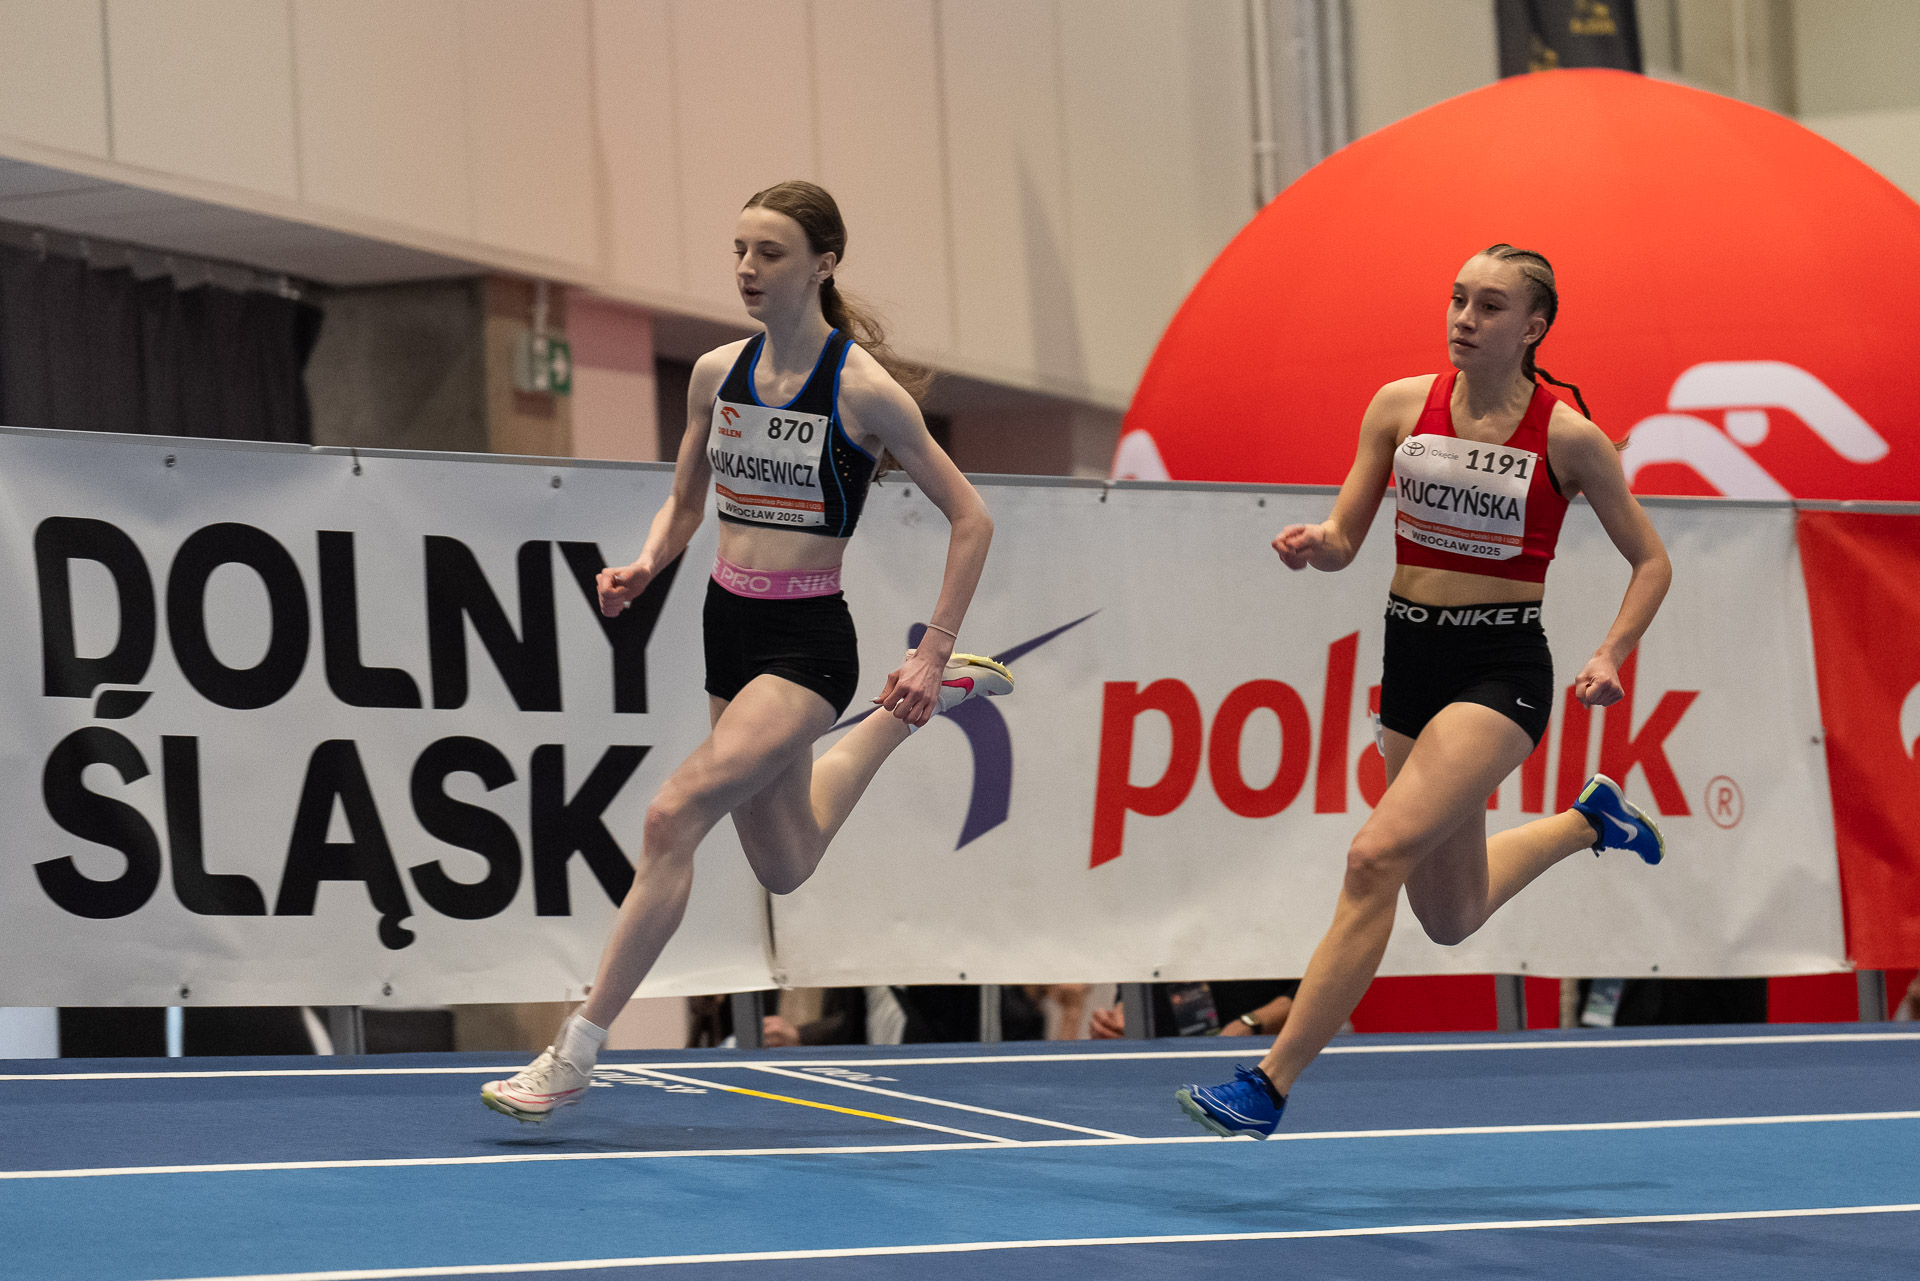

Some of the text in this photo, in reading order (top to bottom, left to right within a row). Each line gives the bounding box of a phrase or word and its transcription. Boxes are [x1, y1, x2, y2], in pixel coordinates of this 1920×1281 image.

[767, 416, 814, 444] 870
[710, 447, 816, 488] ŁUKASIEWICZ
[1465, 449, 1528, 480] 1191
[725, 502, 805, 523] WROCŁAW 2025
[1400, 476, 1520, 521] KUCZYŃSKA
[1411, 530, 1501, 556] WROCŁAW 2025
[720, 565, 771, 593] PRO
[787, 571, 841, 593] NIK
[34, 516, 689, 714] DOLNY
[1436, 607, 1519, 626] NIKE
[34, 689, 654, 950] ŚLĄSK
